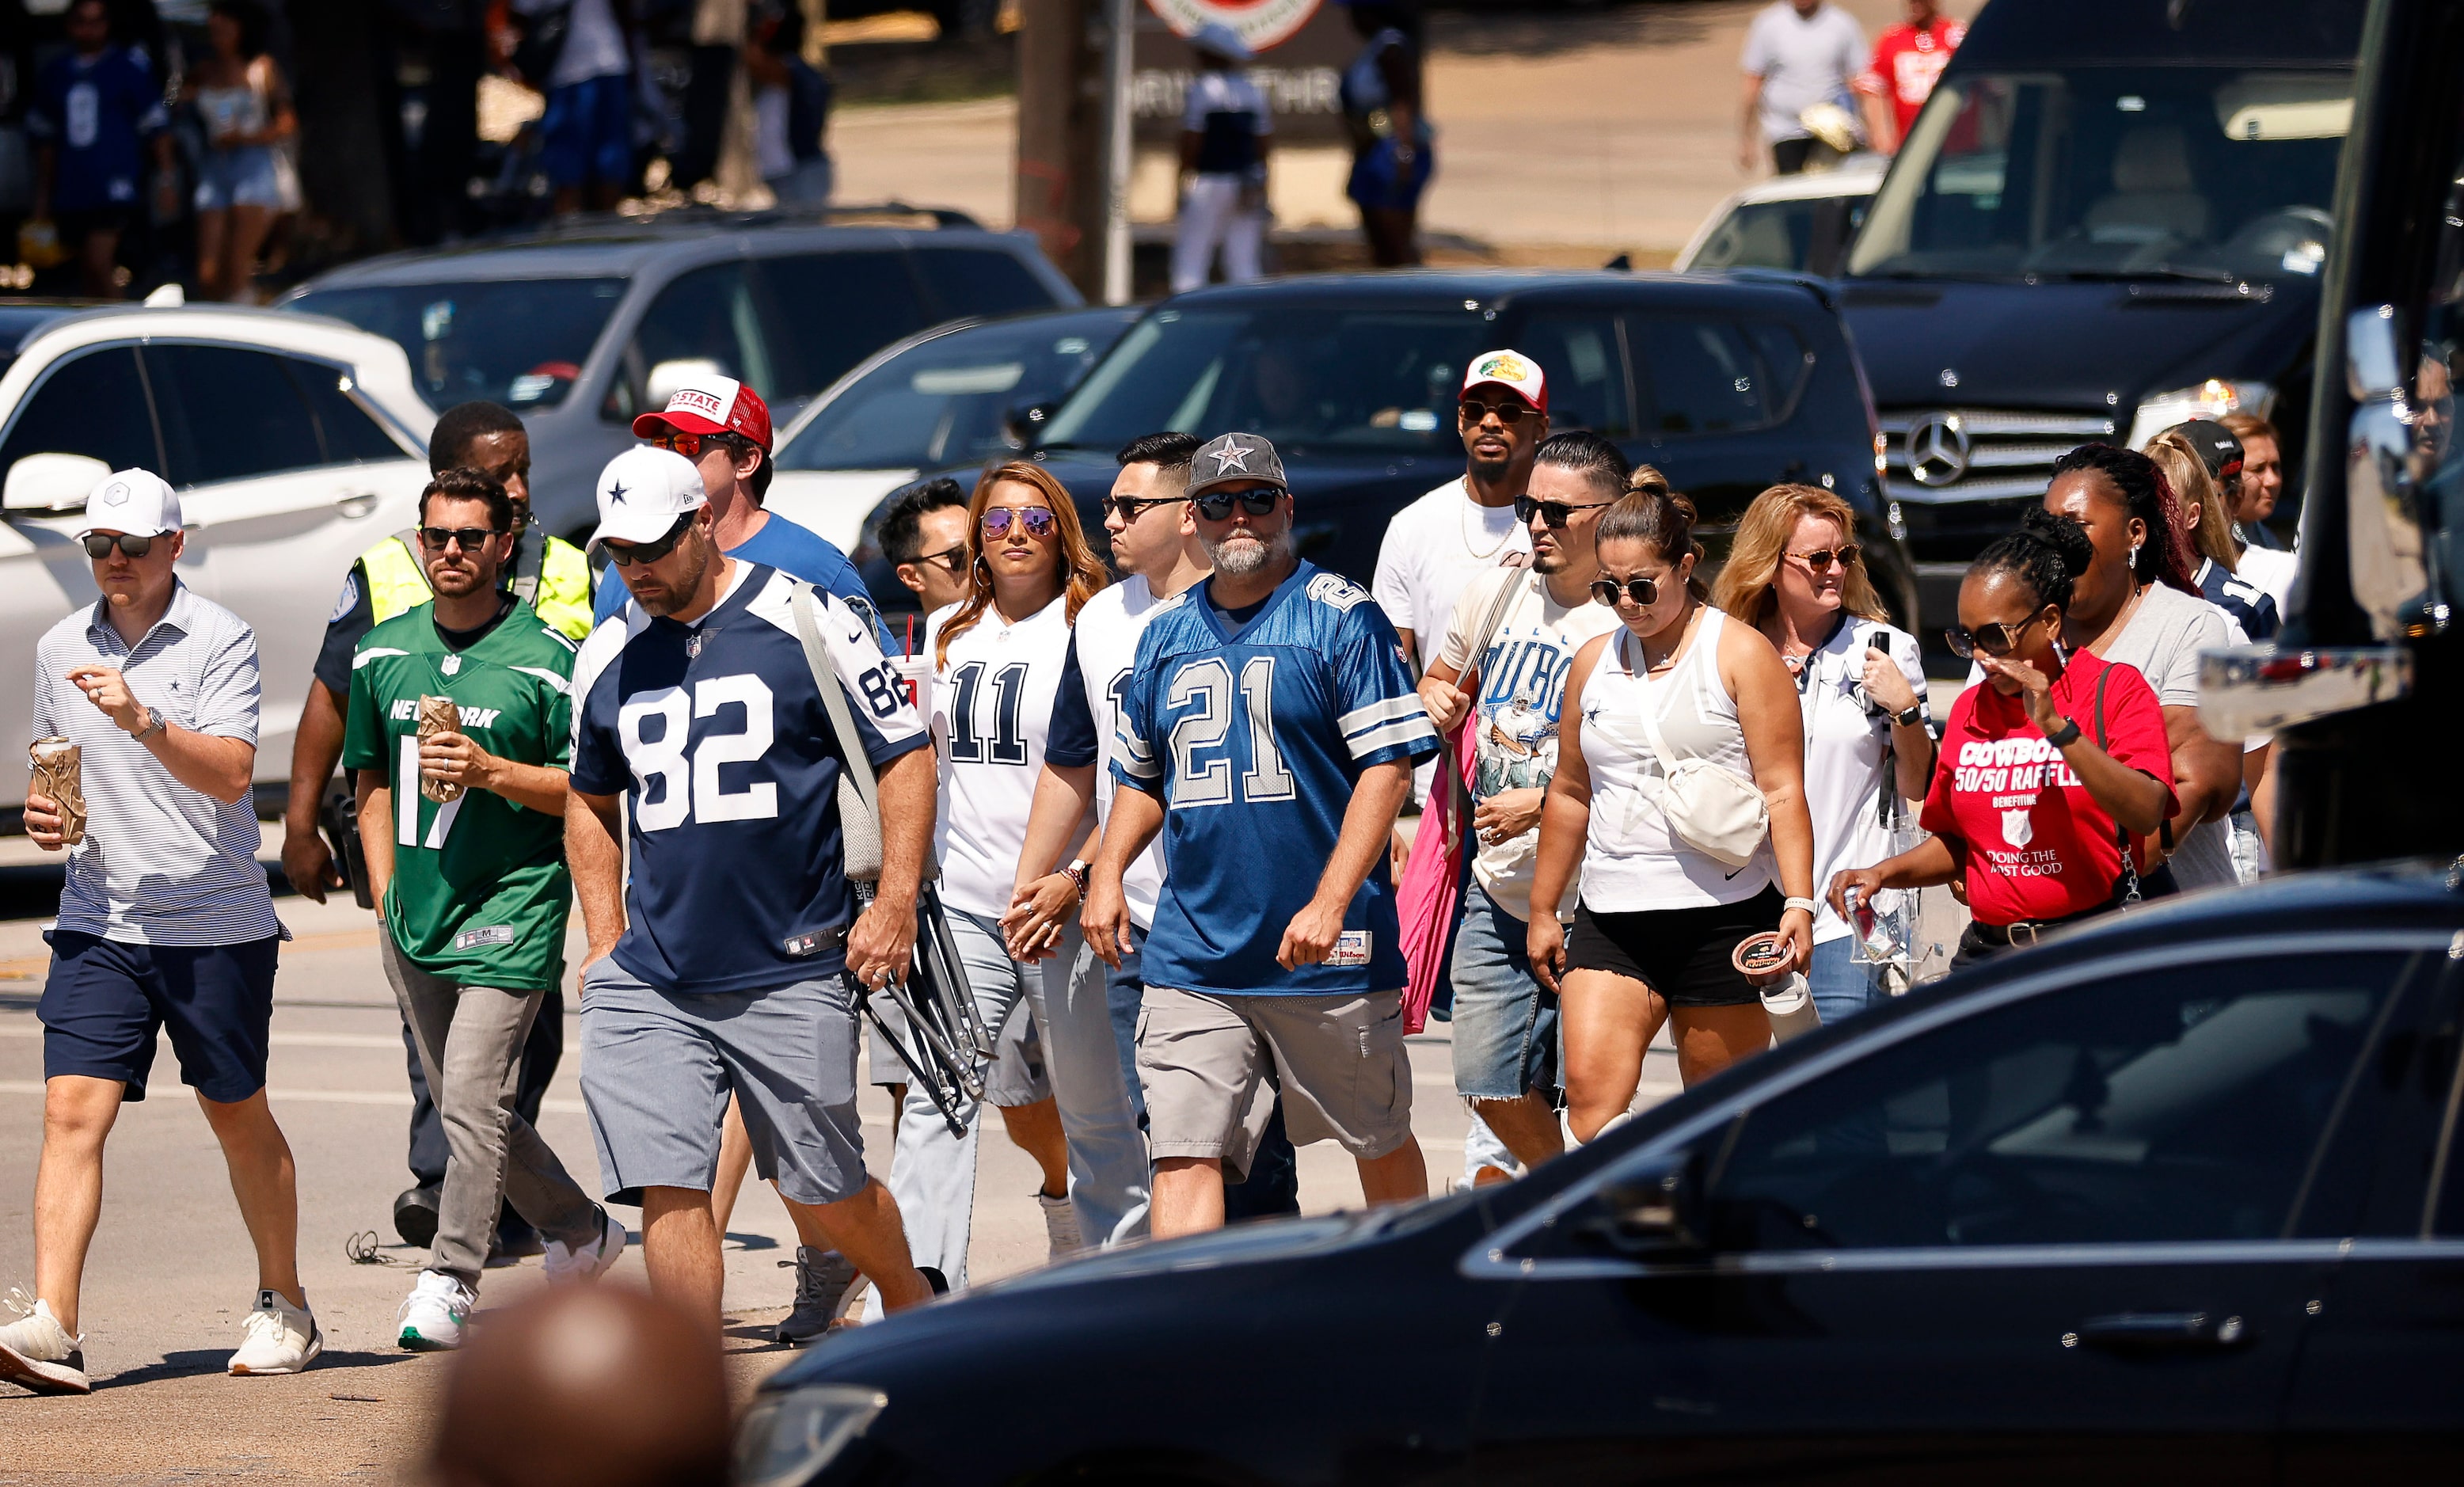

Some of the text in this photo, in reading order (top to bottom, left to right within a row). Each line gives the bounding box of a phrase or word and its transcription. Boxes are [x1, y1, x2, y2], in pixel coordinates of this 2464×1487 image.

[679, 393, 721, 411] STATE
[948, 660, 1029, 766] 11
[1167, 656, 1296, 810] 21
[618, 673, 778, 833] 82
[1959, 737, 2064, 767] COWBO
[1955, 766, 2009, 793] 50/50
[1992, 794, 2037, 808] BENEFITING
[1986, 849, 2057, 864] DOING THE
[2021, 863, 2062, 877] GOOD
